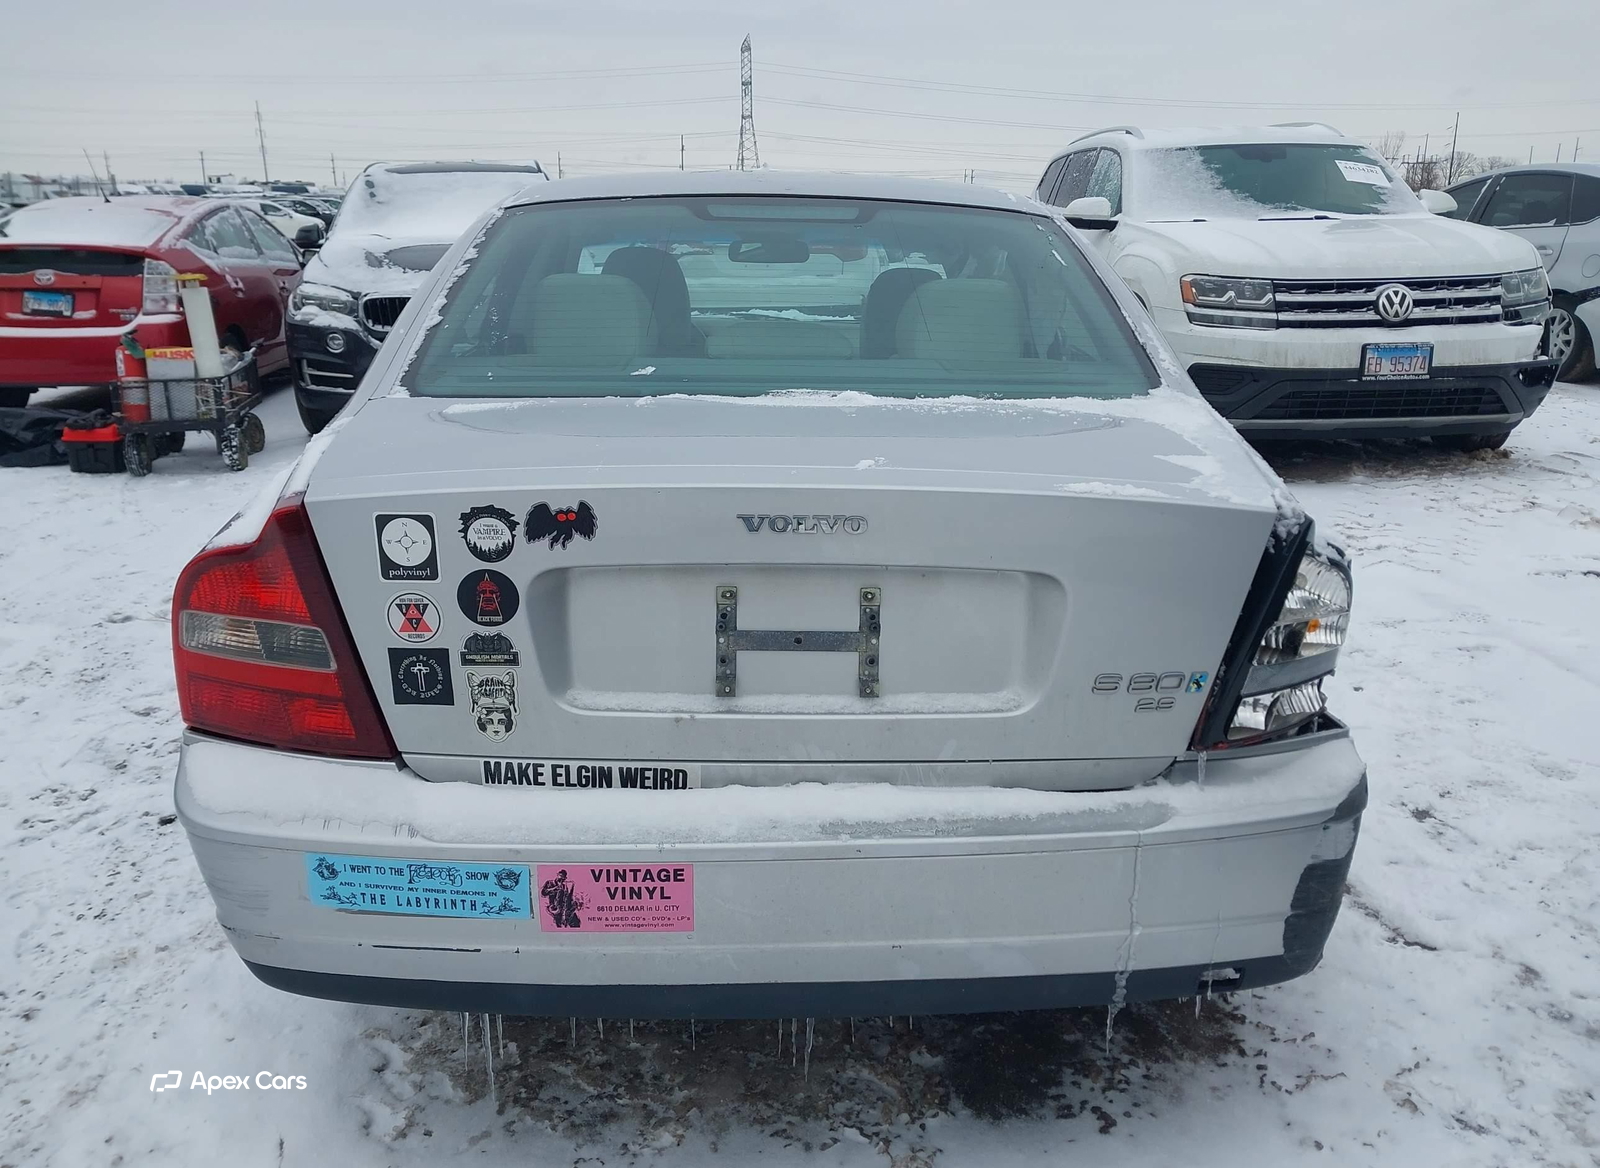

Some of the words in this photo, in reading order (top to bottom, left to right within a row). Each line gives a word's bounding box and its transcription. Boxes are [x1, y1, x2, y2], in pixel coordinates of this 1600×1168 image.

[1368, 356, 1382, 373] FB
[1390, 356, 1427, 372] 95374
[736, 514, 868, 534] VOLVO
[389, 568, 430, 578] polyvinyl
[484, 761, 546, 786] MAKE
[551, 764, 612, 788] ELGIN
[349, 864, 372, 874] WENT
[374, 866, 386, 875] TO
[388, 867, 404, 876] THE
[466, 871, 489, 881] SHOW
[590, 868, 685, 883] VINTAGE
[360, 892, 386, 905] THE
[396, 895, 477, 911] LABYRINTH
[606, 886, 672, 900] VINYL
